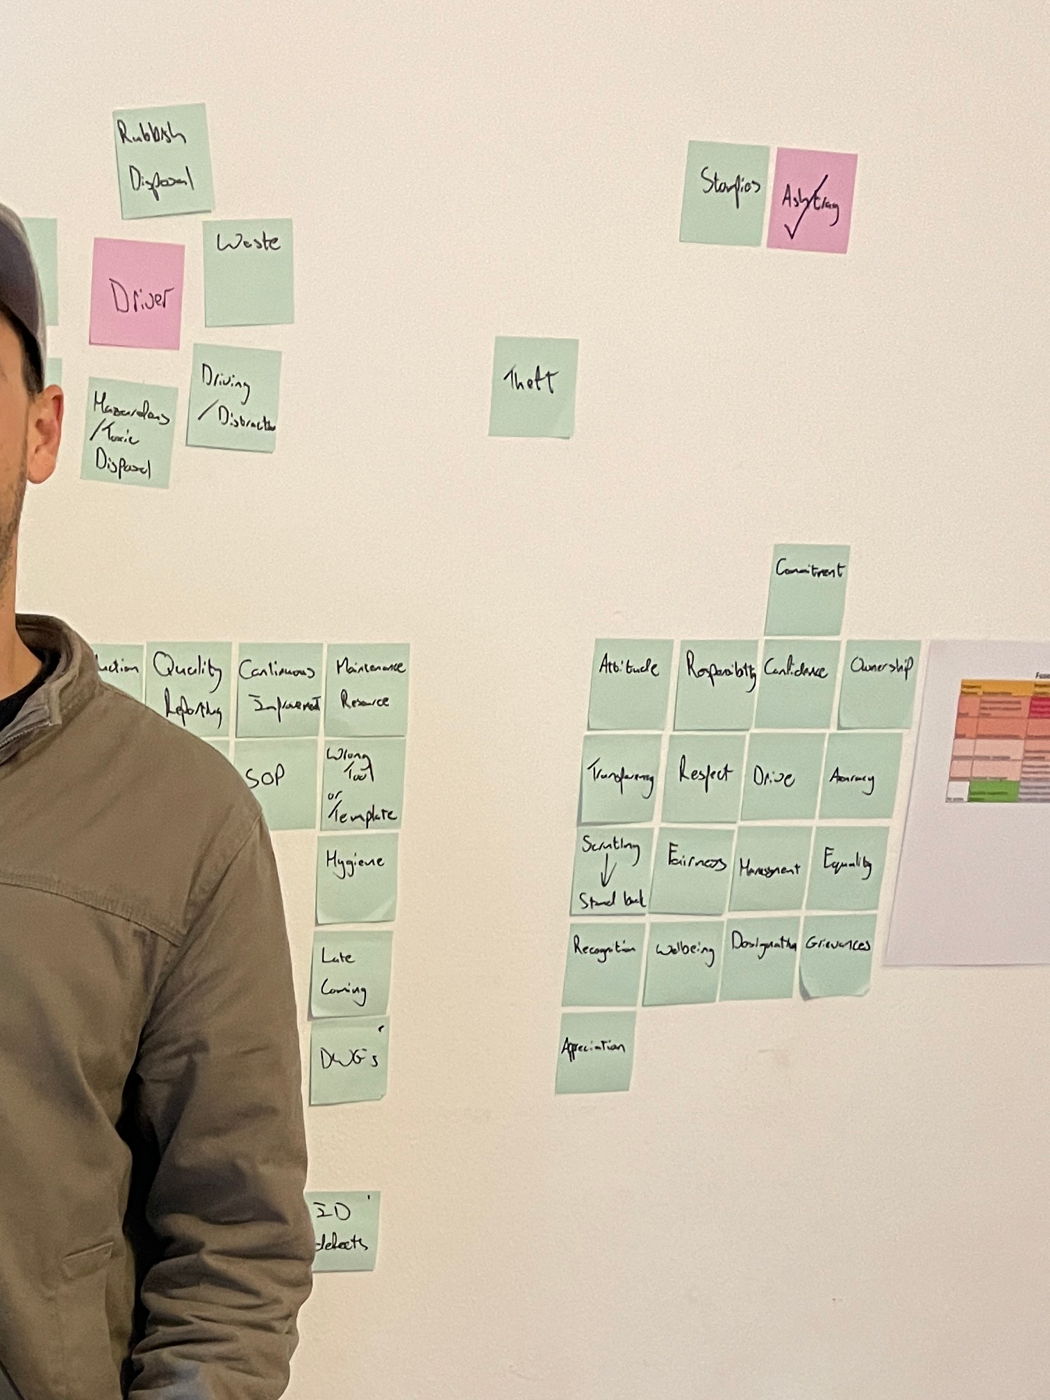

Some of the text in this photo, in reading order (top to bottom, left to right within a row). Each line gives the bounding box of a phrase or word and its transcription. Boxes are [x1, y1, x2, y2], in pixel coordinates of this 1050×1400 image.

[116, 119, 187, 145] Rubbish
[129, 164, 195, 202] Disposal
[216, 230, 281, 252] Waste
[109, 278, 175, 314] Driver
[202, 362, 251, 405] Driving
[503, 364, 560, 394] Theft
[95, 446, 151, 480] Disposal
[153, 650, 223, 693] Quality
[238, 658, 317, 681] Continuous
[336, 656, 408, 675] Maintenance
[598, 652, 660, 678] Attitude
[849, 655, 915, 682] Ownership
[245, 762, 286, 790] SOP
[678, 753, 735, 794] Respect
[753, 764, 796, 787] Drive
[326, 849, 386, 881] Hygiene
[667, 841, 728, 873] Fairness
[579, 889, 617, 910] Stand
[321, 946, 356, 964] Late
[573, 934, 637, 964] Recognition
[805, 935, 872, 953] Grievances
[320, 977, 368, 1008] Coming
